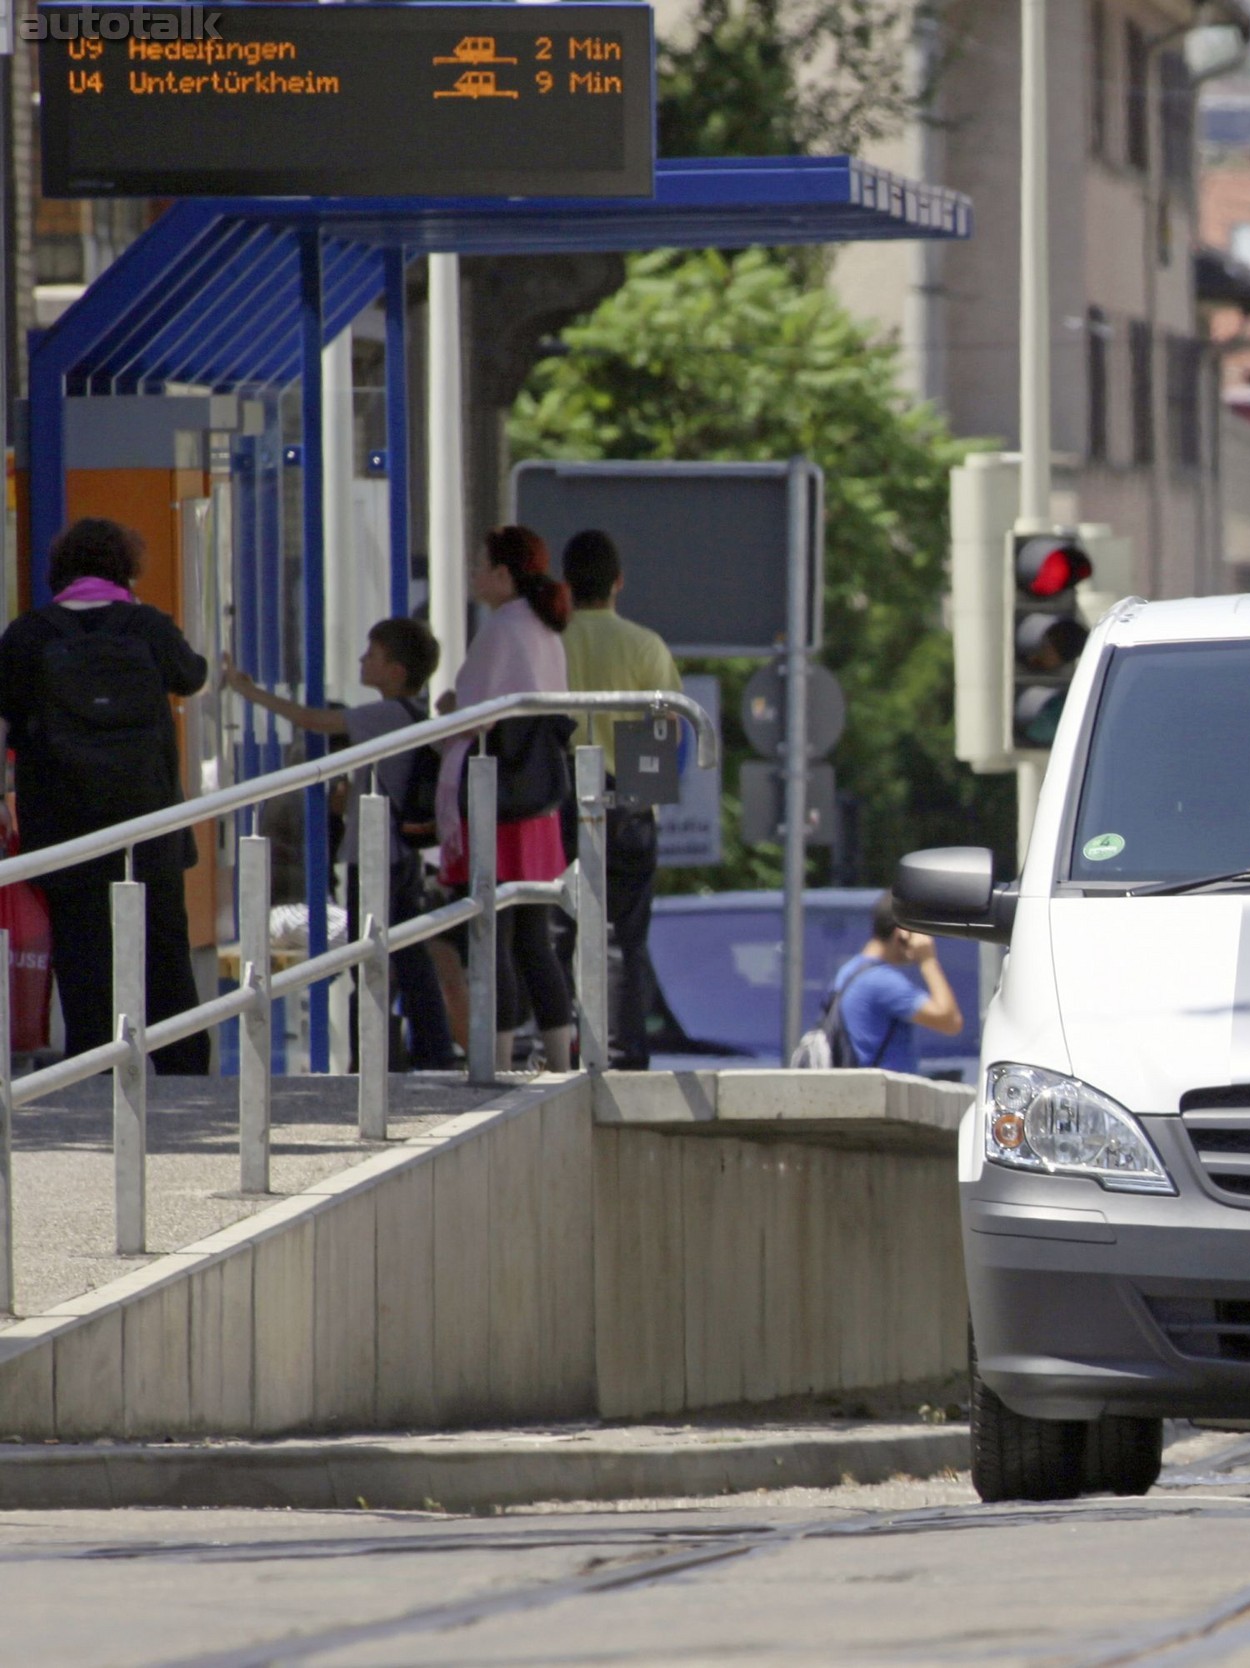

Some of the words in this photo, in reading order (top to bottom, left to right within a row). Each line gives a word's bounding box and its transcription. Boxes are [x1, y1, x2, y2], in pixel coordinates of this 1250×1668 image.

[68, 37, 104, 60] U9
[128, 36, 296, 65] Hedelfingen
[534, 36, 553, 60] 2
[569, 36, 622, 60] Min
[68, 70, 104, 93] U4
[129, 70, 339, 94] Untertürkheim
[534, 70, 554, 94] 9
[569, 71, 623, 94] Min
